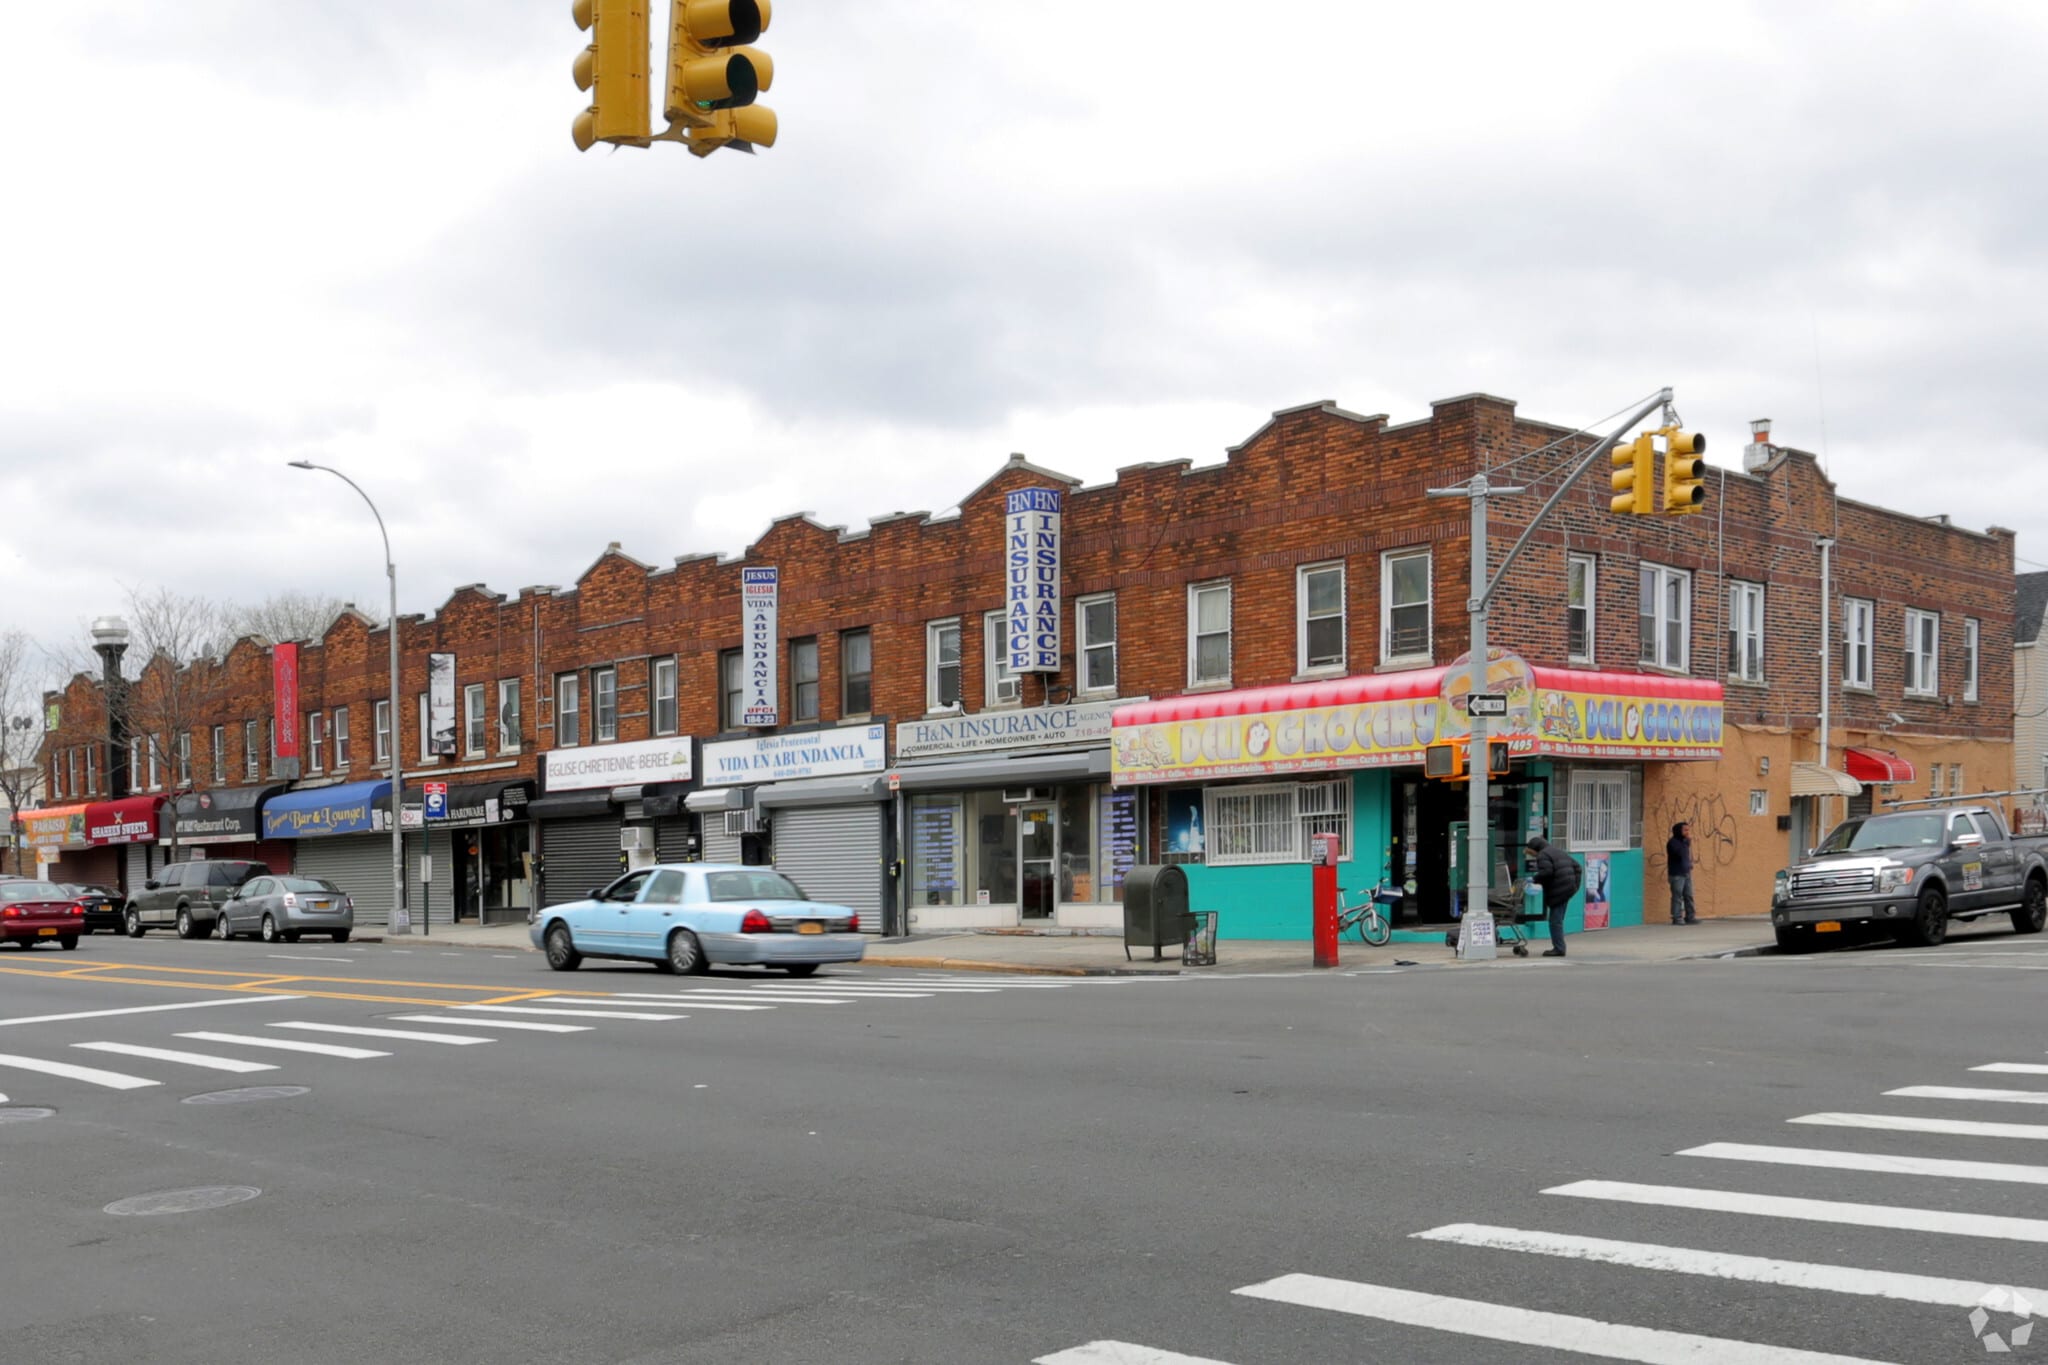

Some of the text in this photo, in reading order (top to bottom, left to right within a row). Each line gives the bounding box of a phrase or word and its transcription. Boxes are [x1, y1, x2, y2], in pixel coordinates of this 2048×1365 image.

[1007, 491, 1032, 513] HN
[1033, 489, 1059, 512] HN
[745, 571, 775, 582] JESUS
[746, 585, 774, 594] IGLESIA
[1010, 515, 1030, 668] INSURANCE
[1036, 514, 1057, 667] INSURANCE
[747, 600, 774, 608] VIDA
[753, 613, 768, 706] ABUNDANCIA
[1490, 701, 1503, 709] WAY
[916, 722, 954, 743] H&N
[959, 708, 1078, 738] INSURANCE
[1585, 698, 1623, 740] DELI
[1642, 702, 1722, 743] GROCERY
[756, 733, 821, 751] Iglesia Pentecostal
[906, 731, 1066, 754] COMMERCIAL LIFE HOMEOWNER AUTO
[1180, 719, 1242, 764] DELI
[1276, 702, 1437, 756] GROCERY
[548, 752, 670, 777] EGLISE CHRETIENNE BEREE
[718, 757, 749, 772] VIDA
[753, 754, 770, 769] EN
[773, 743, 865, 768] ABUNDANCIA
[289, 810, 310, 830] Bar
[312, 811, 321, 823] &
[321, 807, 361, 828] Lounge
